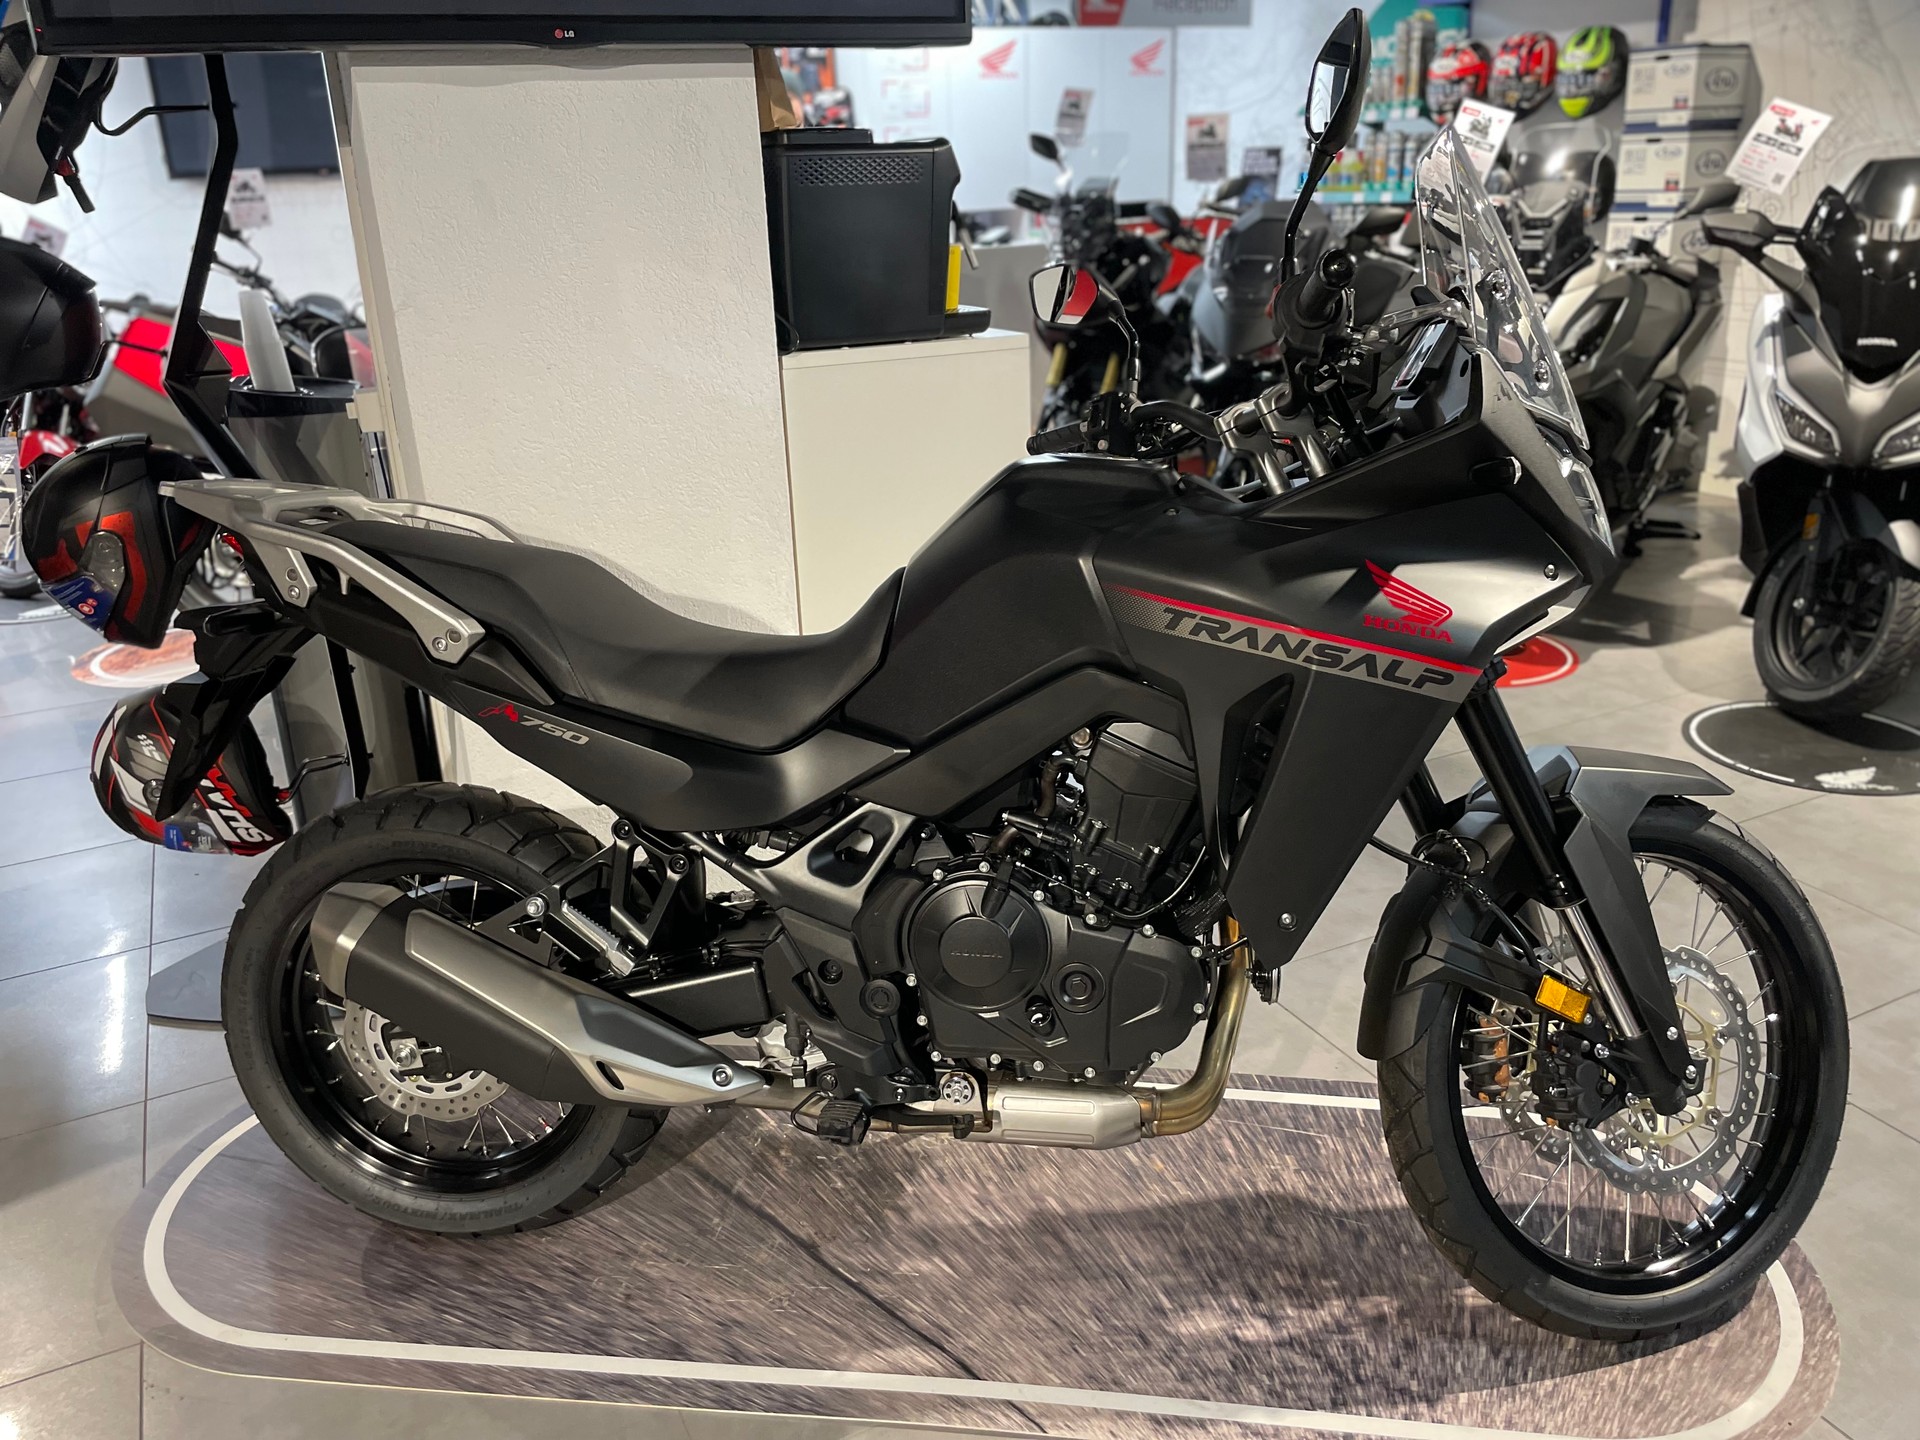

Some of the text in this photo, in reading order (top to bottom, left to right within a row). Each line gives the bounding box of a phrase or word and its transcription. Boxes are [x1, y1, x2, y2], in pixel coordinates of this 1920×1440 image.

[1363, 614, 1454, 644] HONDA
[1163, 607, 1455, 690] TRANSALP
[520, 715, 590, 745] 750
